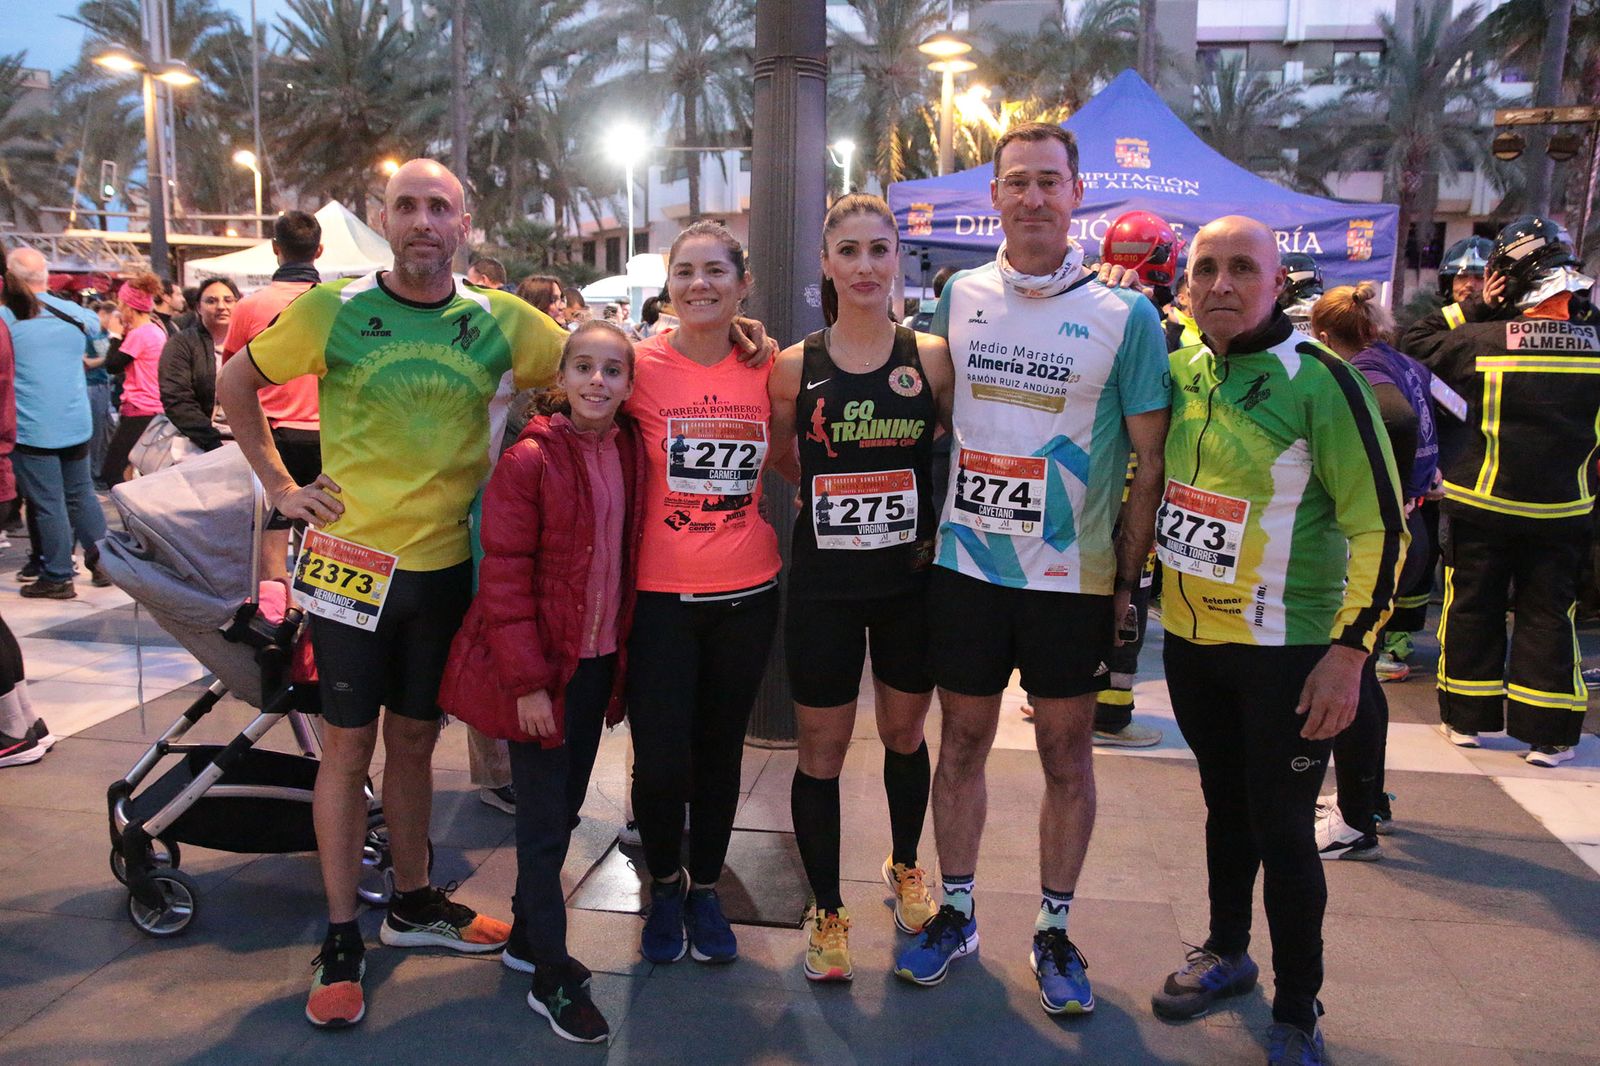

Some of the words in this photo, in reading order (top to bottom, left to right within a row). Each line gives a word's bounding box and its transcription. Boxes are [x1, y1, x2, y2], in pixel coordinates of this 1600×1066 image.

[1509, 321, 1594, 338] BOMBEROS
[969, 340, 1008, 355] Medio
[1012, 345, 1074, 366] Maratón
[1518, 336, 1593, 350] ALMERIA
[967, 353, 1024, 375] Almería
[966, 373, 997, 384] RAMÓN
[999, 377, 1020, 388] RUIZ
[1022, 382, 1068, 396] ANDÚJAR
[659, 406, 708, 417] CARRERA
[710, 404, 762, 414] BOMBEROS
[831, 418, 926, 443] TRAINING
[695, 442, 757, 469] 272
[969, 475, 1031, 508] 274
[840, 494, 906, 524] 275
[978, 505, 1014, 519] CAYETANO
[857, 523, 889, 535] VIRGINIA
[1167, 510, 1227, 551] 273
[1188, 547, 1219, 563] TORRES
[309, 558, 374, 595] 2373
[313, 587, 357, 610] HERNANDEZ
[1202, 595, 1242, 605] Retamar
